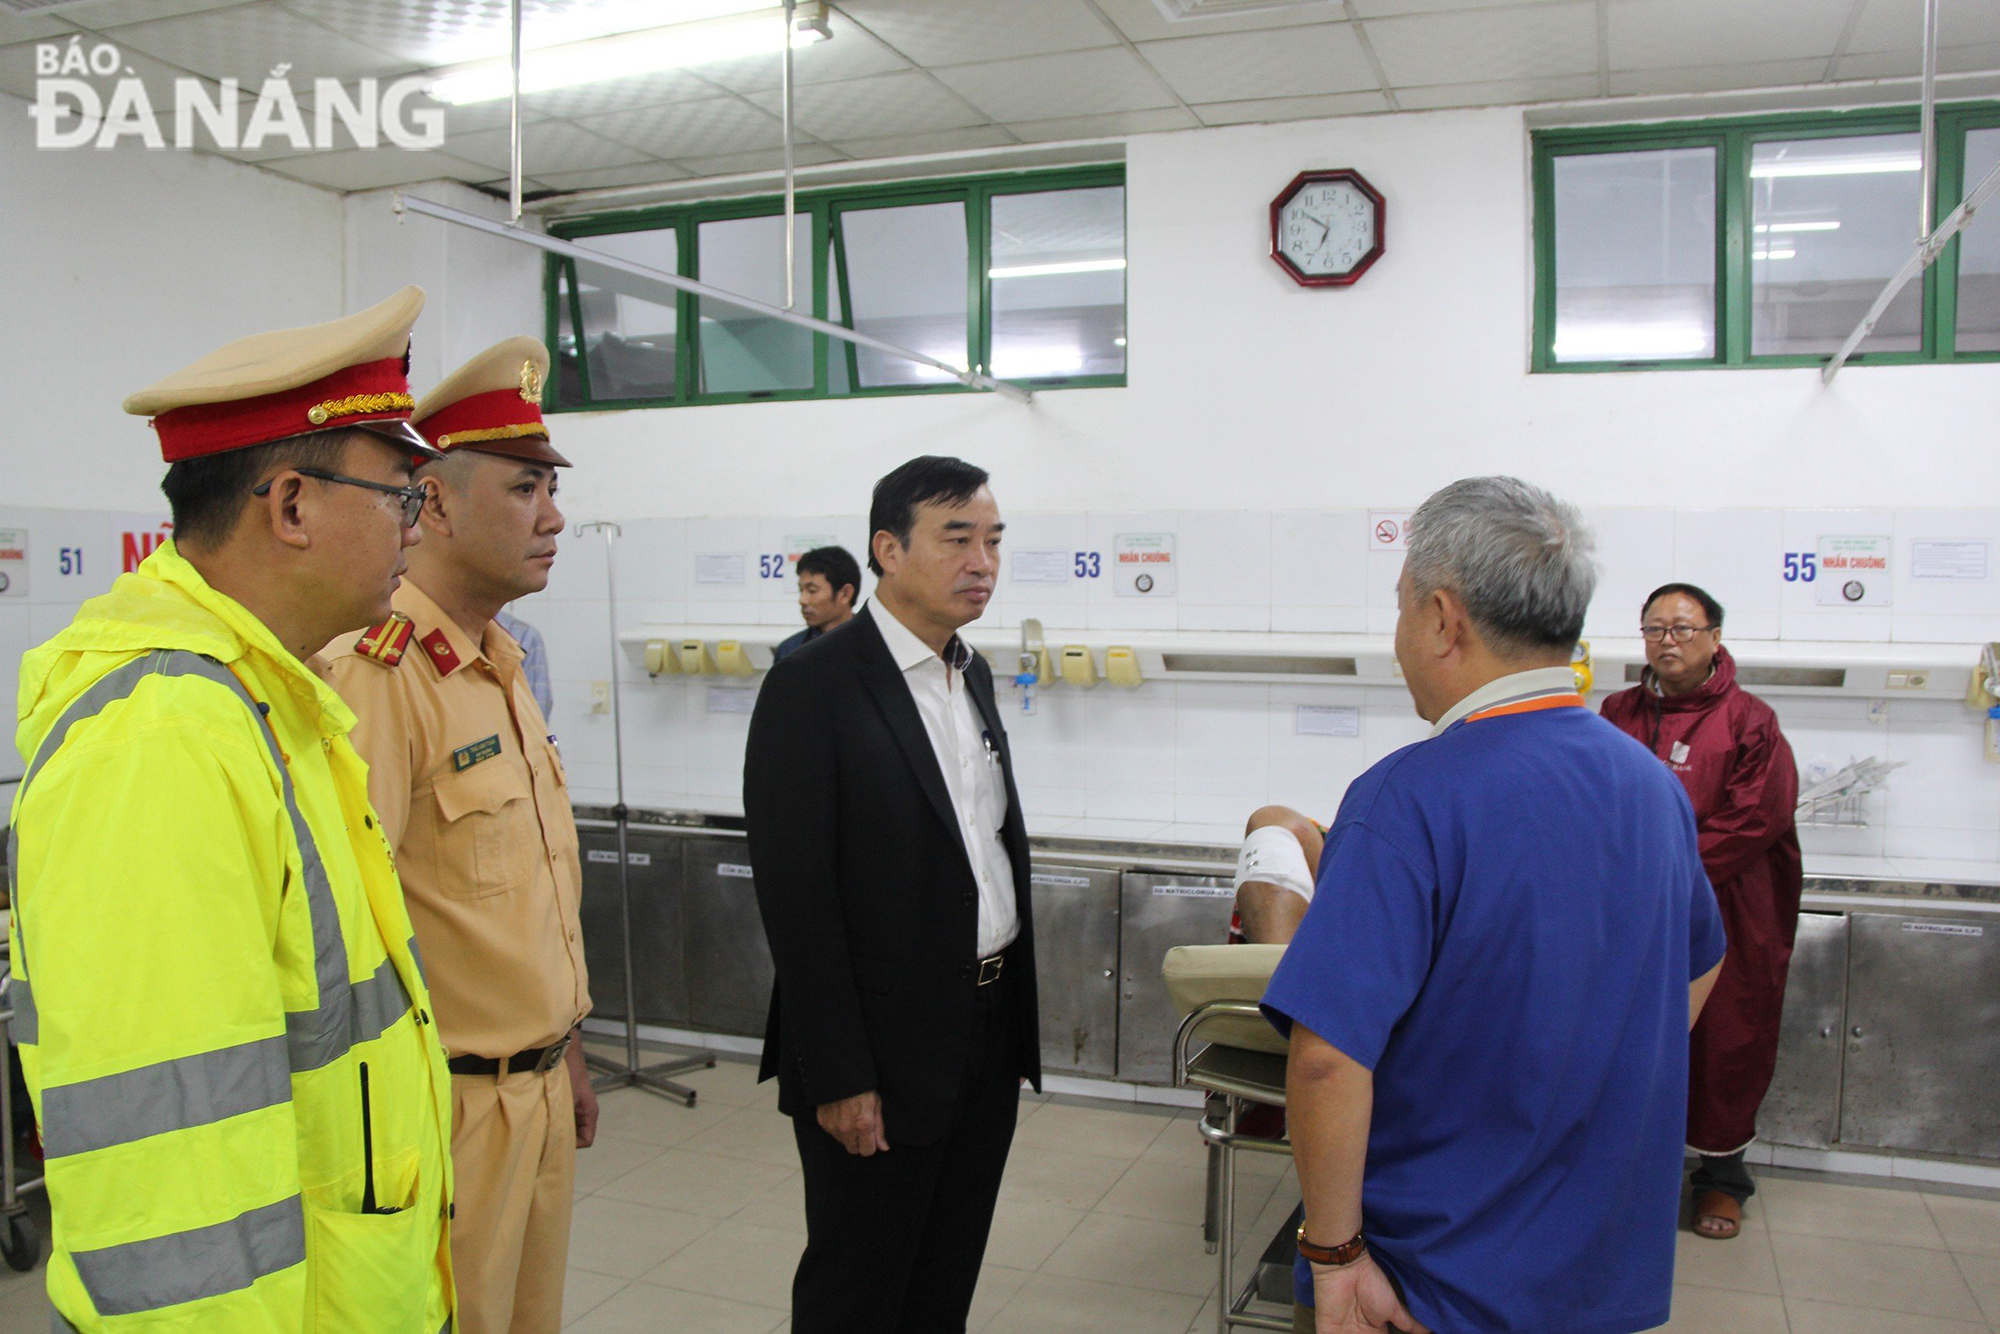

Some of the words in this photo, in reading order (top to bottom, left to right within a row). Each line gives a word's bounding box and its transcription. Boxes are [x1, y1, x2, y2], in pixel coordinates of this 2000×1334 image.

[1305, 194, 1313, 206] 11
[1322, 190, 1336, 201] 12
[1292, 209, 1305, 220] 10
[1355, 204, 1364, 216] 2
[1290, 224, 1301, 236] 9
[1357, 221, 1367, 233] 3
[1292, 241, 1303, 252] 8
[1305, 253, 1314, 265] 7
[1323, 256, 1334, 269] 6
[1342, 253, 1352, 265] 5
[60, 548, 82, 575] 51
[760, 554, 784, 578] 52
[1075, 552, 1100, 578] 53
[1784, 553, 1816, 582] 55
